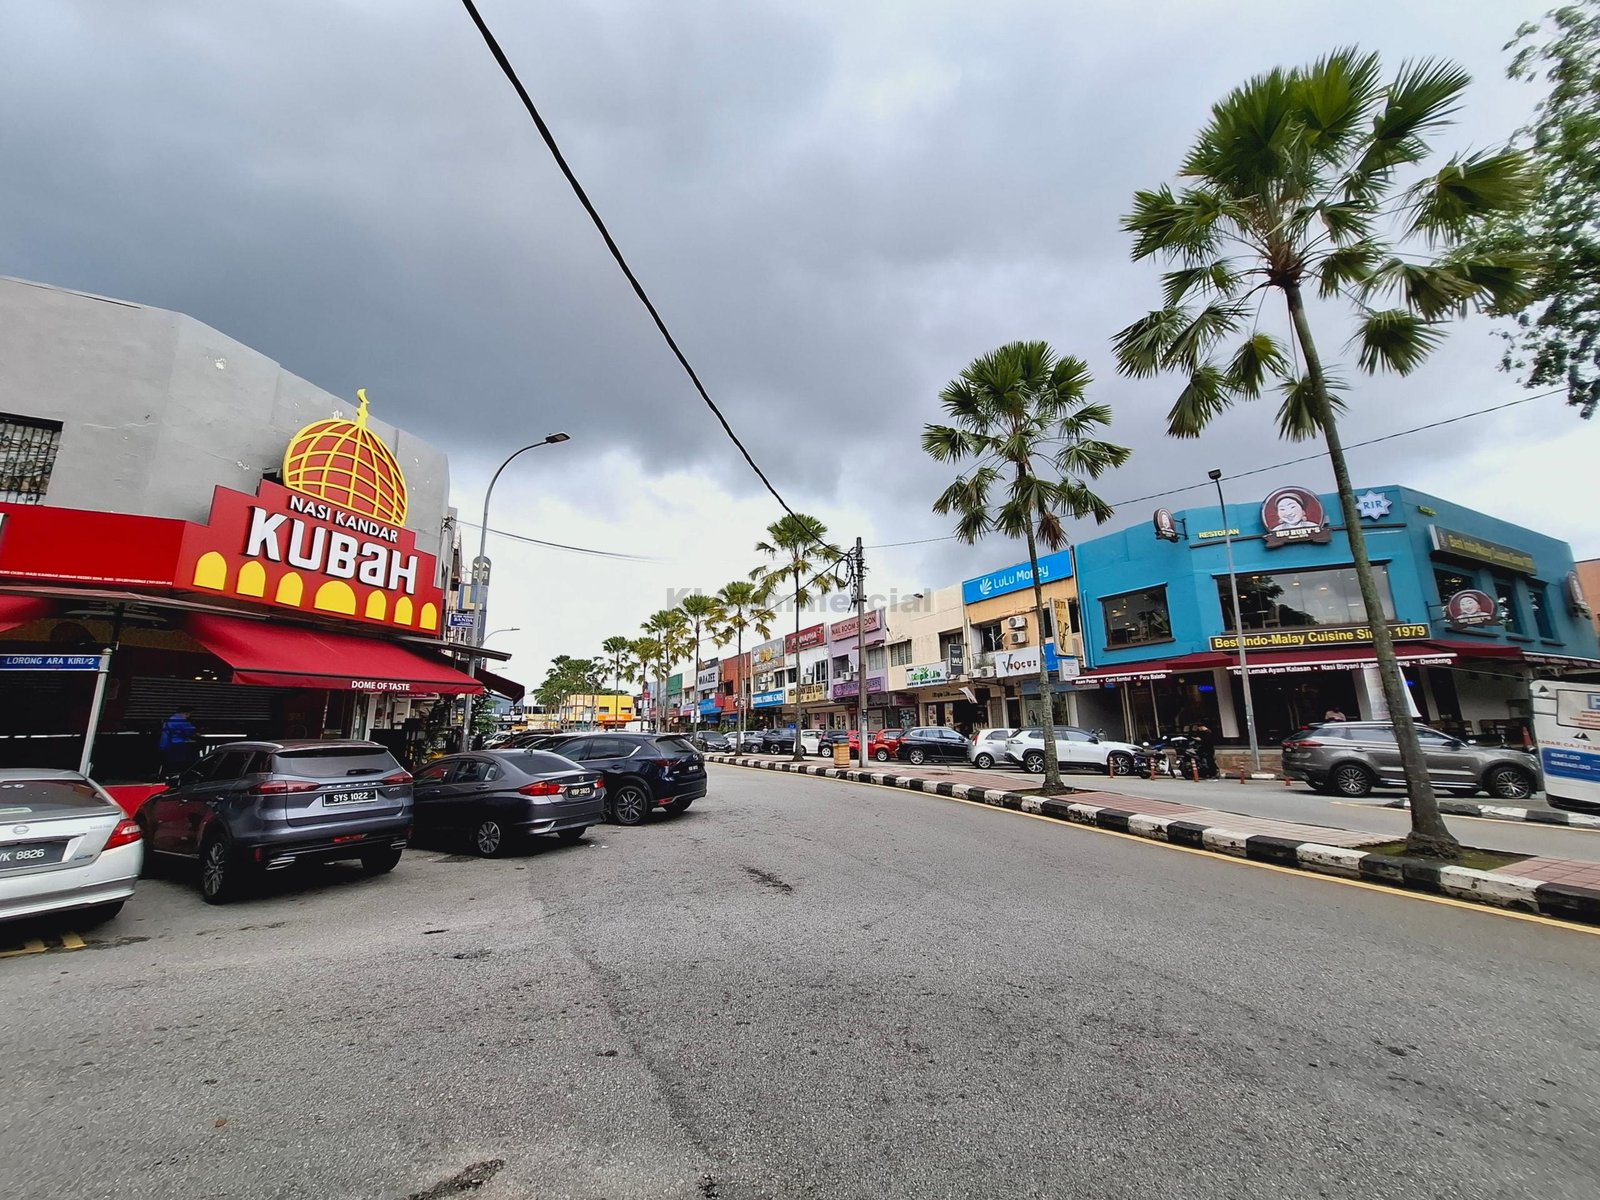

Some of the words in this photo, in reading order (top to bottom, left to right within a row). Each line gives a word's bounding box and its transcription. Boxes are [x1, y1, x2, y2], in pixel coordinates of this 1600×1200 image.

[1363, 500, 1383, 510] RIR
[290, 496, 331, 521] NASI
[335, 511, 398, 543] KANDAR
[994, 575, 1015, 589] LuLu
[842, 623, 856, 632] ROOM
[856, 616, 876, 628] SOON
[1215, 638, 1239, 648] Best
[1243, 633, 1305, 647] Indo-Malay
[1308, 631, 1353, 643] Cuisine
[1356, 629, 1392, 640] Sie
[1395, 626, 1426, 637] 1979
[7, 657, 42, 665] LORONG
[46, 657, 64, 665] ARA
[1336, 662, 1359, 670] Biryani
[351, 680, 376, 689] DOME
[389, 683, 410, 691] TASTE
[333, 794, 348, 802] SYS
[350, 792, 368, 800] 1022
[16, 849, 45, 860] 8826
